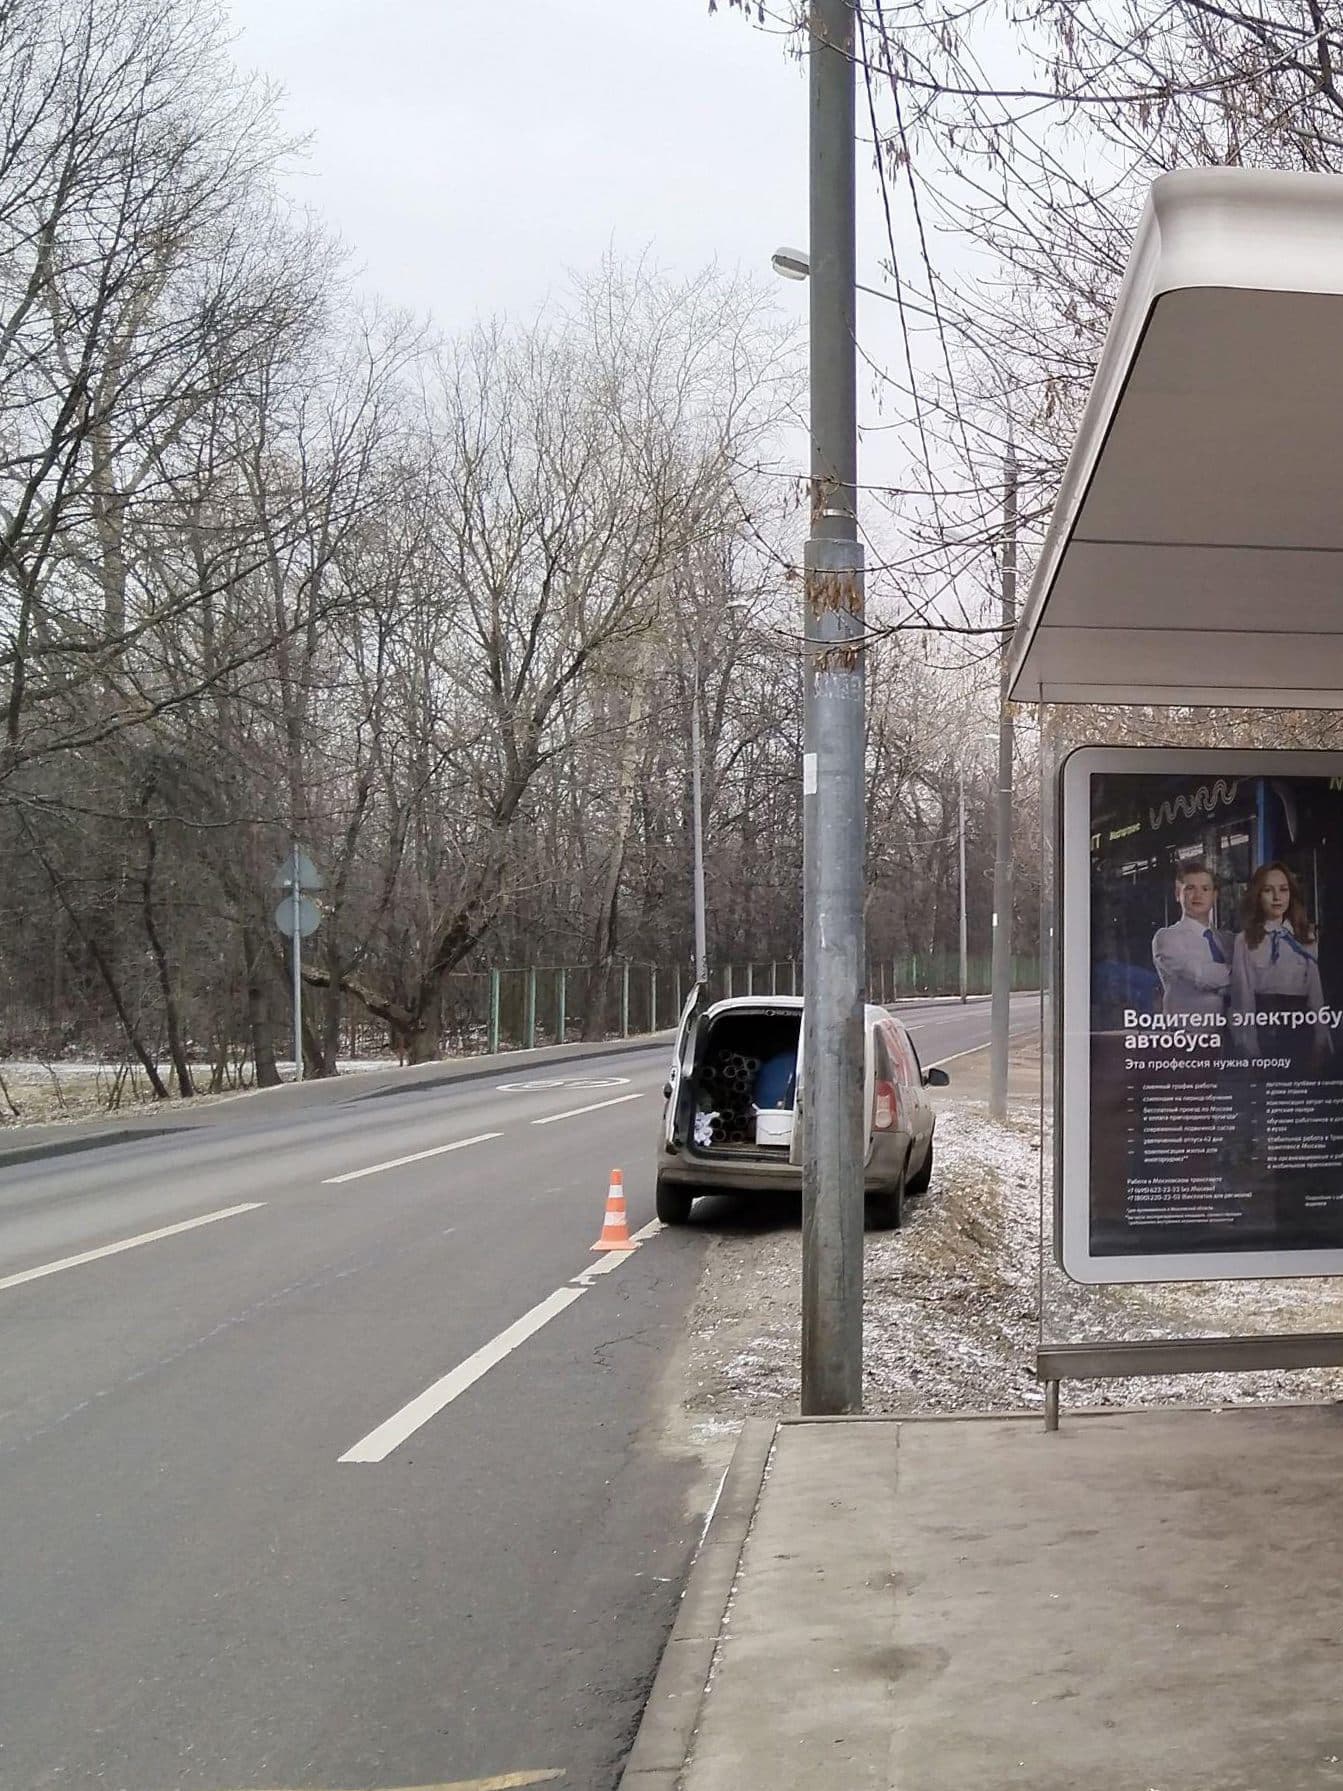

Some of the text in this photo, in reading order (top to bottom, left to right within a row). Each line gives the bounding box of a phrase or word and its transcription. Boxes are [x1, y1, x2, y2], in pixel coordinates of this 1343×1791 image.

[1123, 1008, 1227, 1029] Водитель
[1124, 1030, 1222, 1052] автобуса
[1125, 1056, 1292, 1073] Эта профессия нужна городу
